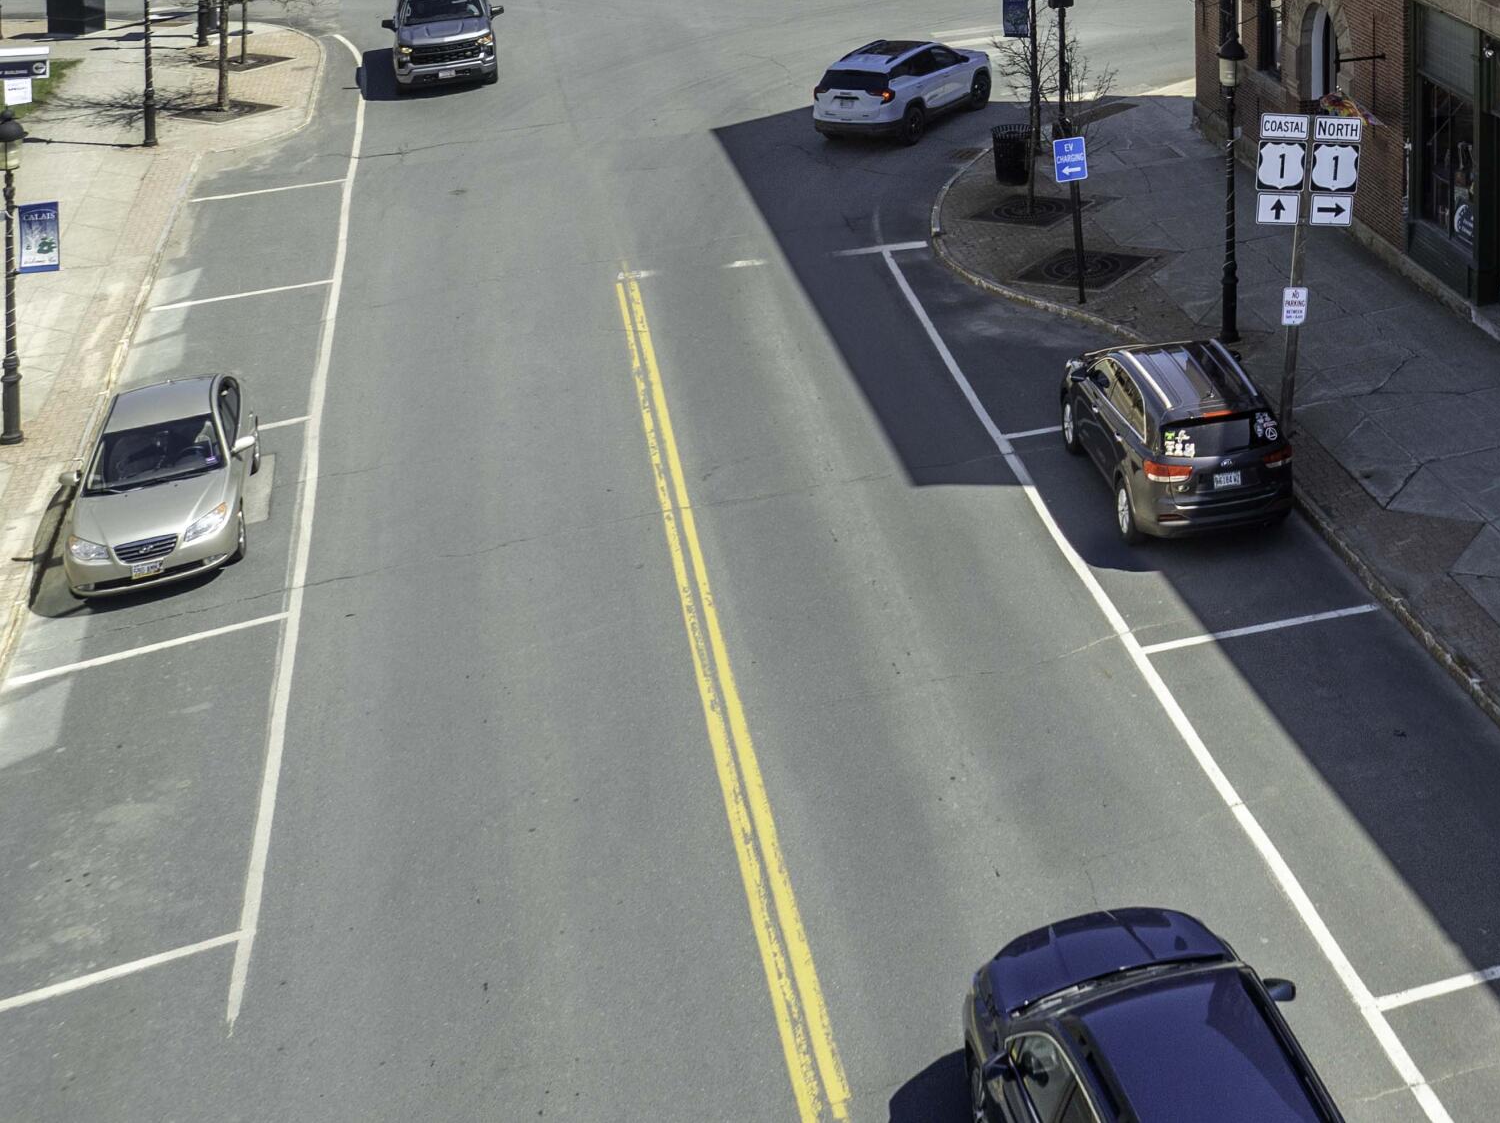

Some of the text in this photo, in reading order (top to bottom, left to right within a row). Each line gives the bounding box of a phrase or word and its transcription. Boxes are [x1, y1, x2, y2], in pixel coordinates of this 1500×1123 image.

[1263, 120, 1306, 134] COASTAL
[1318, 120, 1359, 137] NORTH
[1064, 143, 1073, 152] EV
[1056, 152, 1084, 164] CHARGING
[1279, 153, 1286, 179] 1
[1332, 155, 1339, 181] 1
[23, 212, 56, 221] CALAIS
[1292, 291, 1300, 299] NO
[1285, 300, 1305, 308] PARKING
